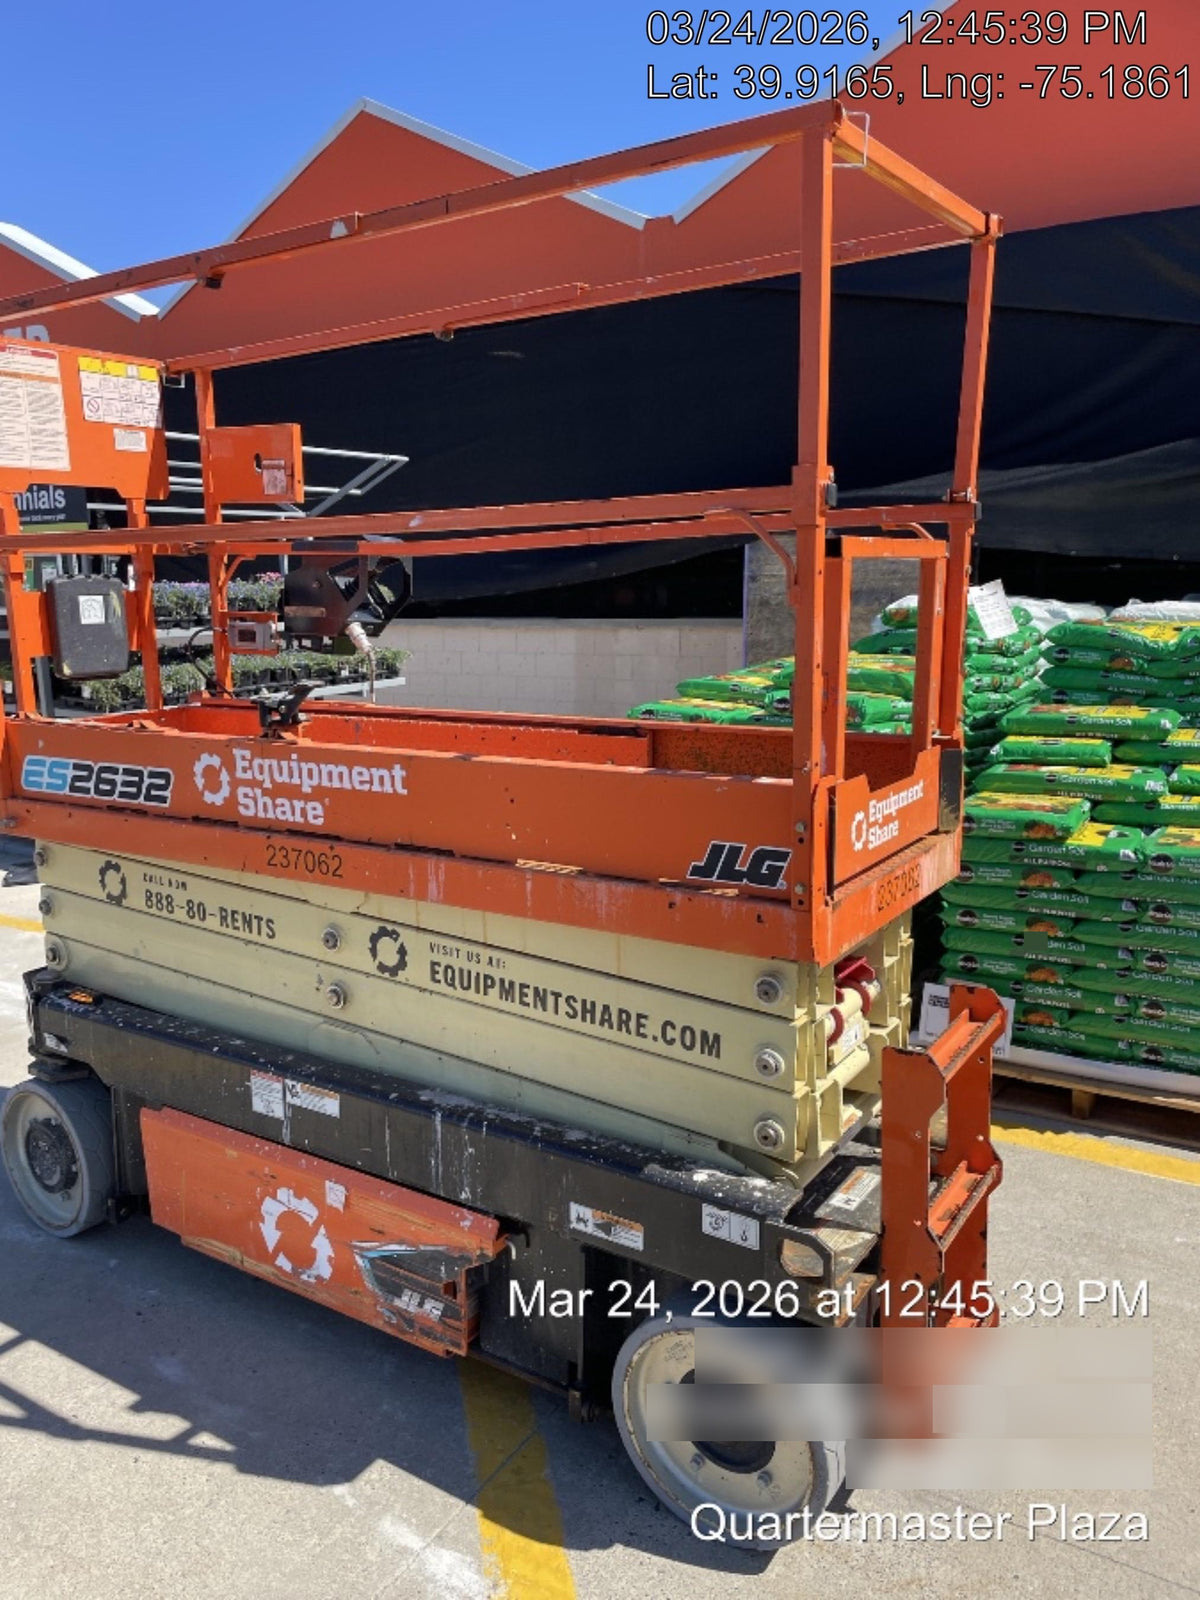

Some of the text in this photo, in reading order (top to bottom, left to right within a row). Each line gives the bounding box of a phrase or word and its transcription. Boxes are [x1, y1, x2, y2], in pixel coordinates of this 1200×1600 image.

[21, 754, 173, 807] ES2632
[232, 748, 408, 795] Equipment
[236, 786, 325, 826] Share
[868, 779, 924, 824] Equipment
[867, 819, 899, 850] Share
[265, 844, 343, 878] 237062
[686, 841, 792, 889] JLG
[144, 888, 276, 939] 888-80-RENTS
[429, 941, 461, 959] VISIT
[466, 950, 481, 964] US
[428, 959, 722, 1059] EQUIPMENTSHARE.COM
